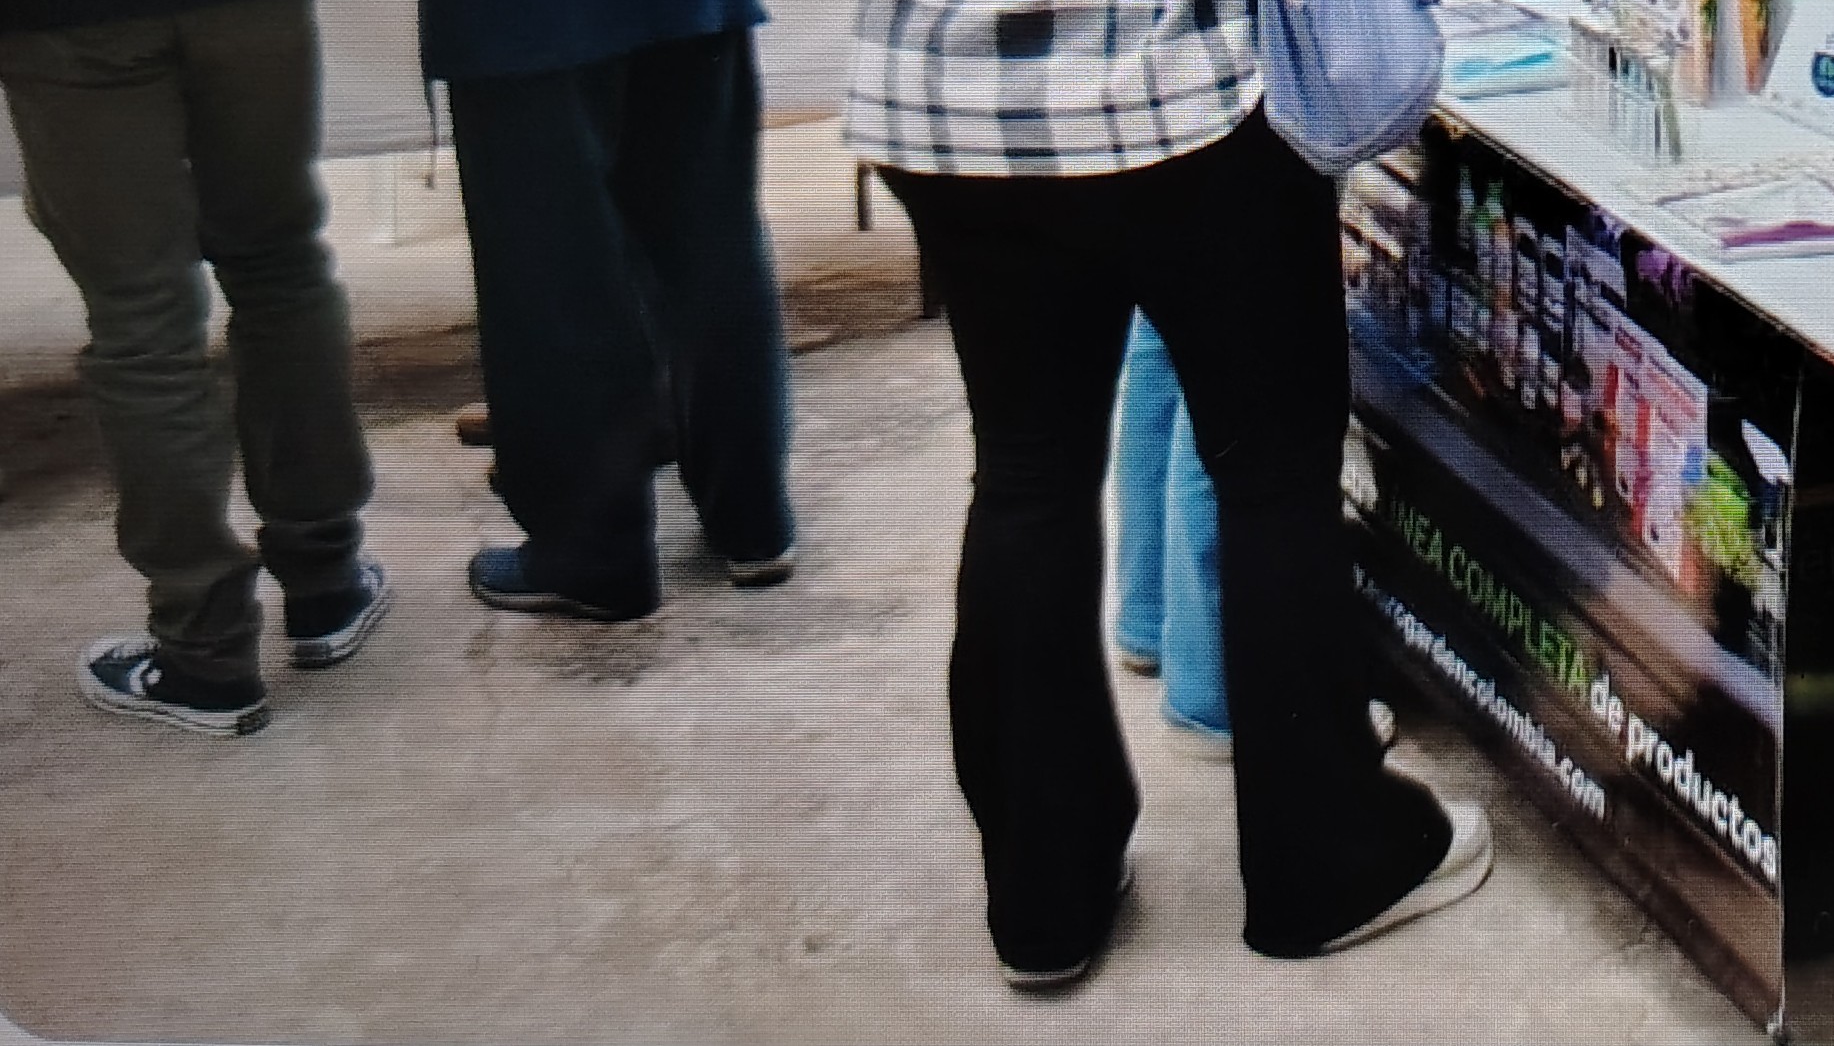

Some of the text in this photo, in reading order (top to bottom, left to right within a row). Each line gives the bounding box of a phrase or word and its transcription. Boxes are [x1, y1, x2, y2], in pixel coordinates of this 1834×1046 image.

[1450, 544, 1592, 702] COMPLETA
[1591, 674, 1624, 733] de
[1626, 712, 1777, 885] productos
